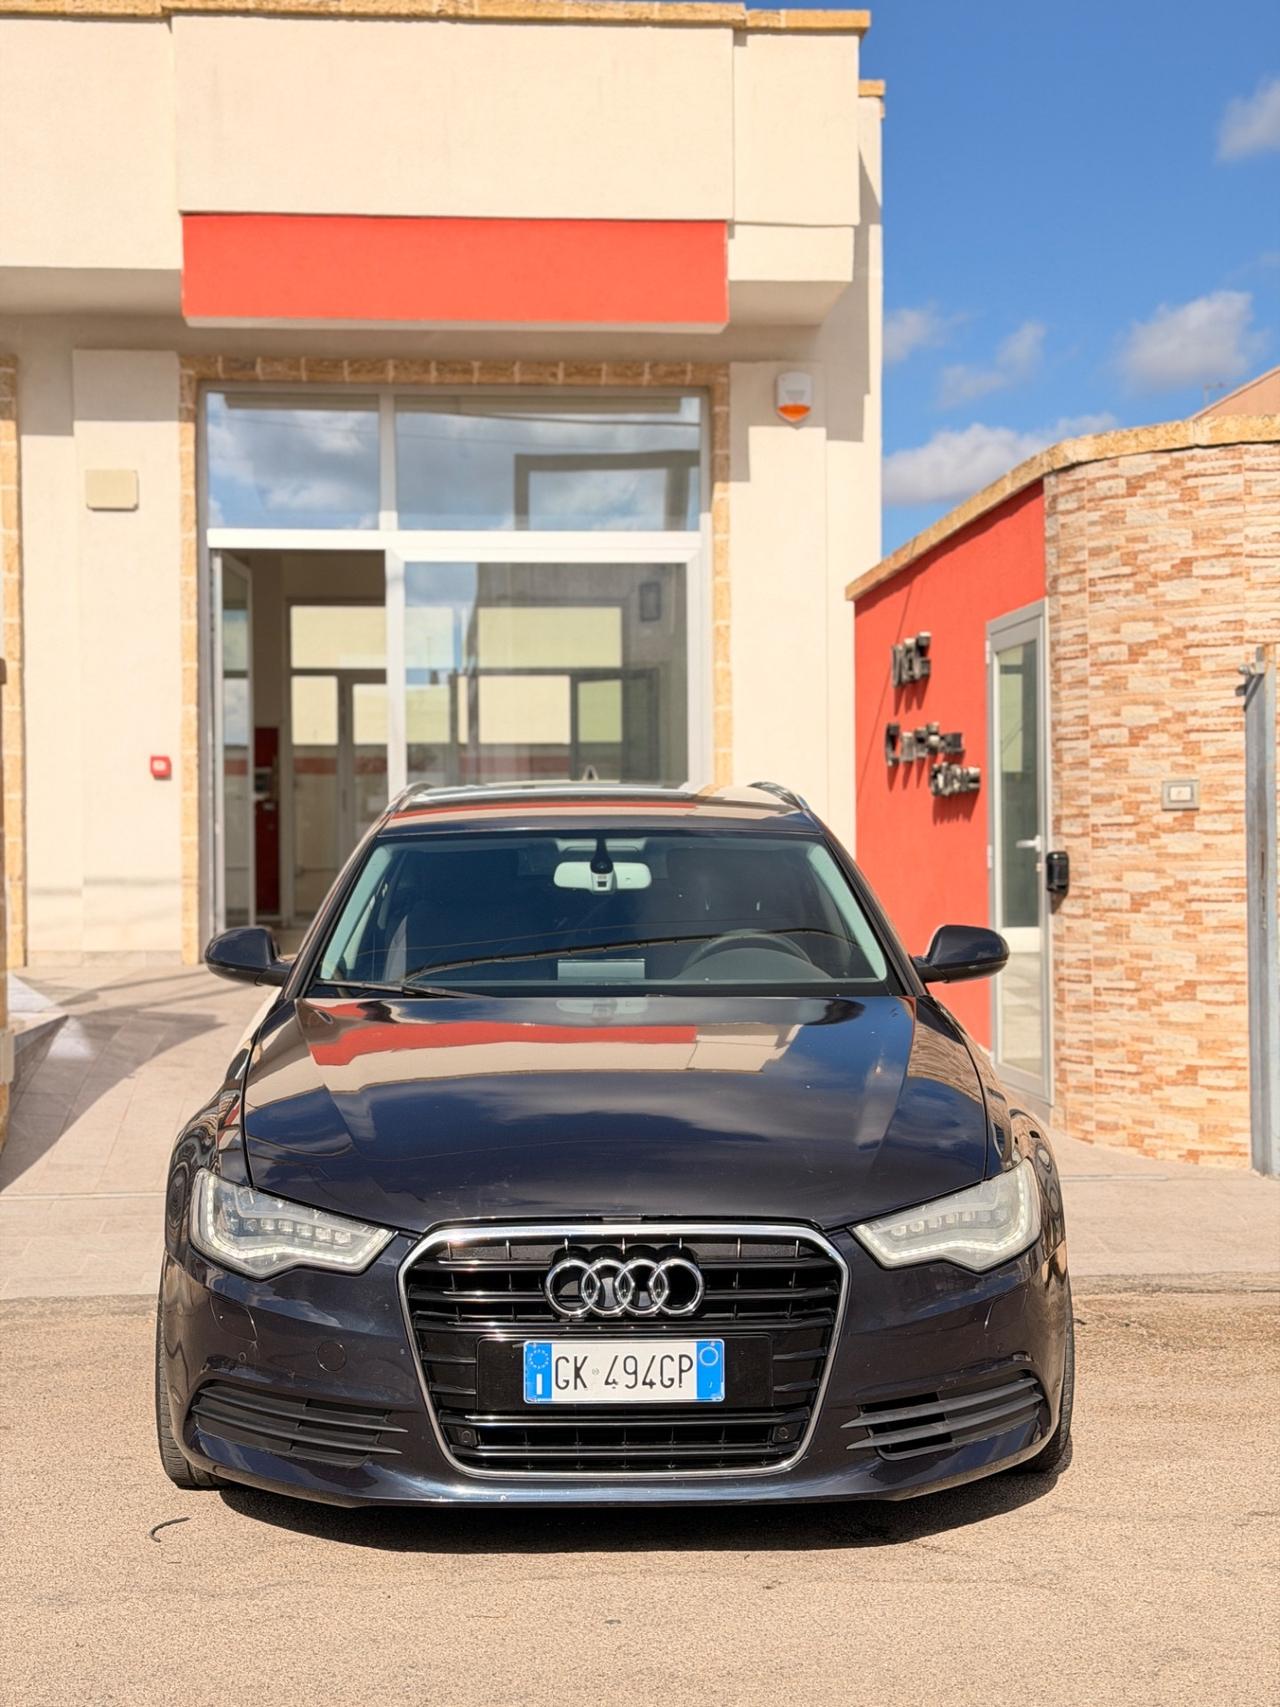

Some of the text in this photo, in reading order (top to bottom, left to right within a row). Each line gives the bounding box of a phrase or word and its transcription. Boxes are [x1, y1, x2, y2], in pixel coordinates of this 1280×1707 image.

[536, 1354, 694, 1395] I GK 494GP
